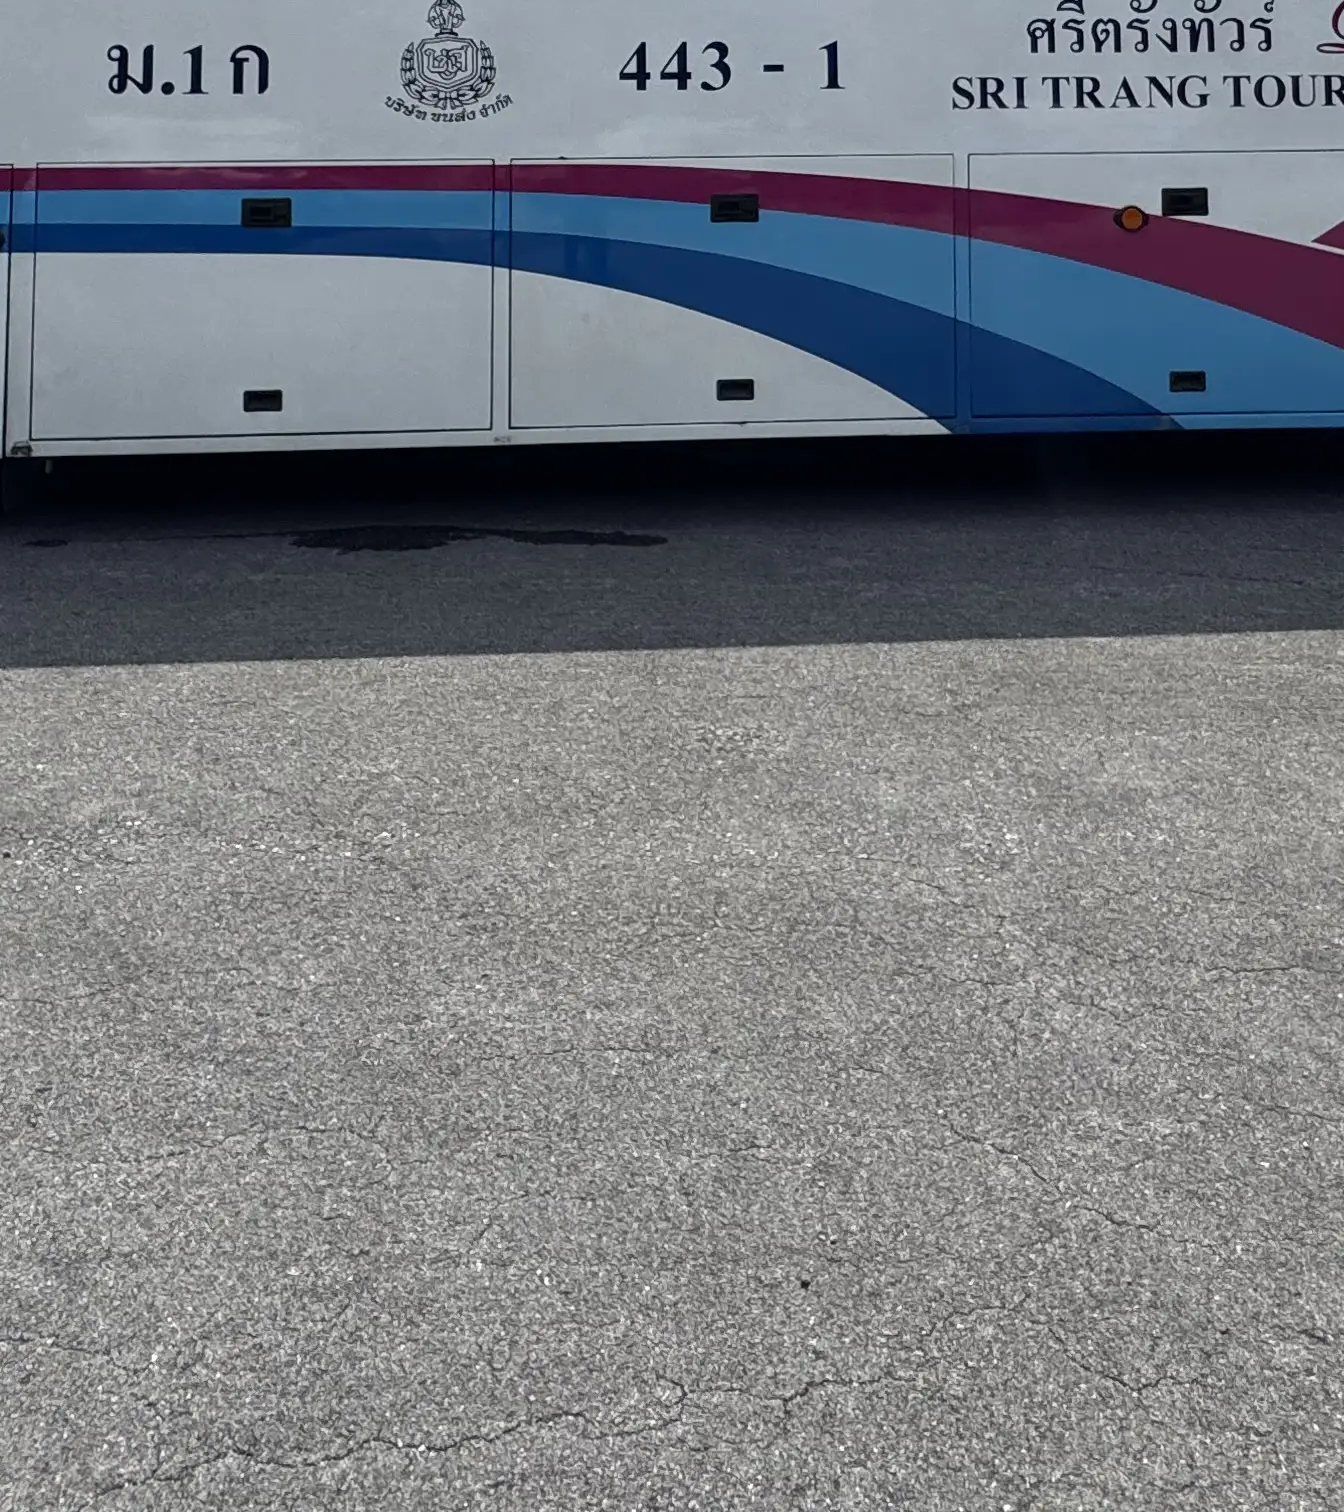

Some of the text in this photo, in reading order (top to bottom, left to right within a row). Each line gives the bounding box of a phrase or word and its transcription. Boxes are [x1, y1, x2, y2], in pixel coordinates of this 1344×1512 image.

[618, 40, 732, 92] 443
[818, 39, 847, 90] 1
[951, 76, 1030, 110] SRI
[1041, 76, 1212, 110] TRANG
